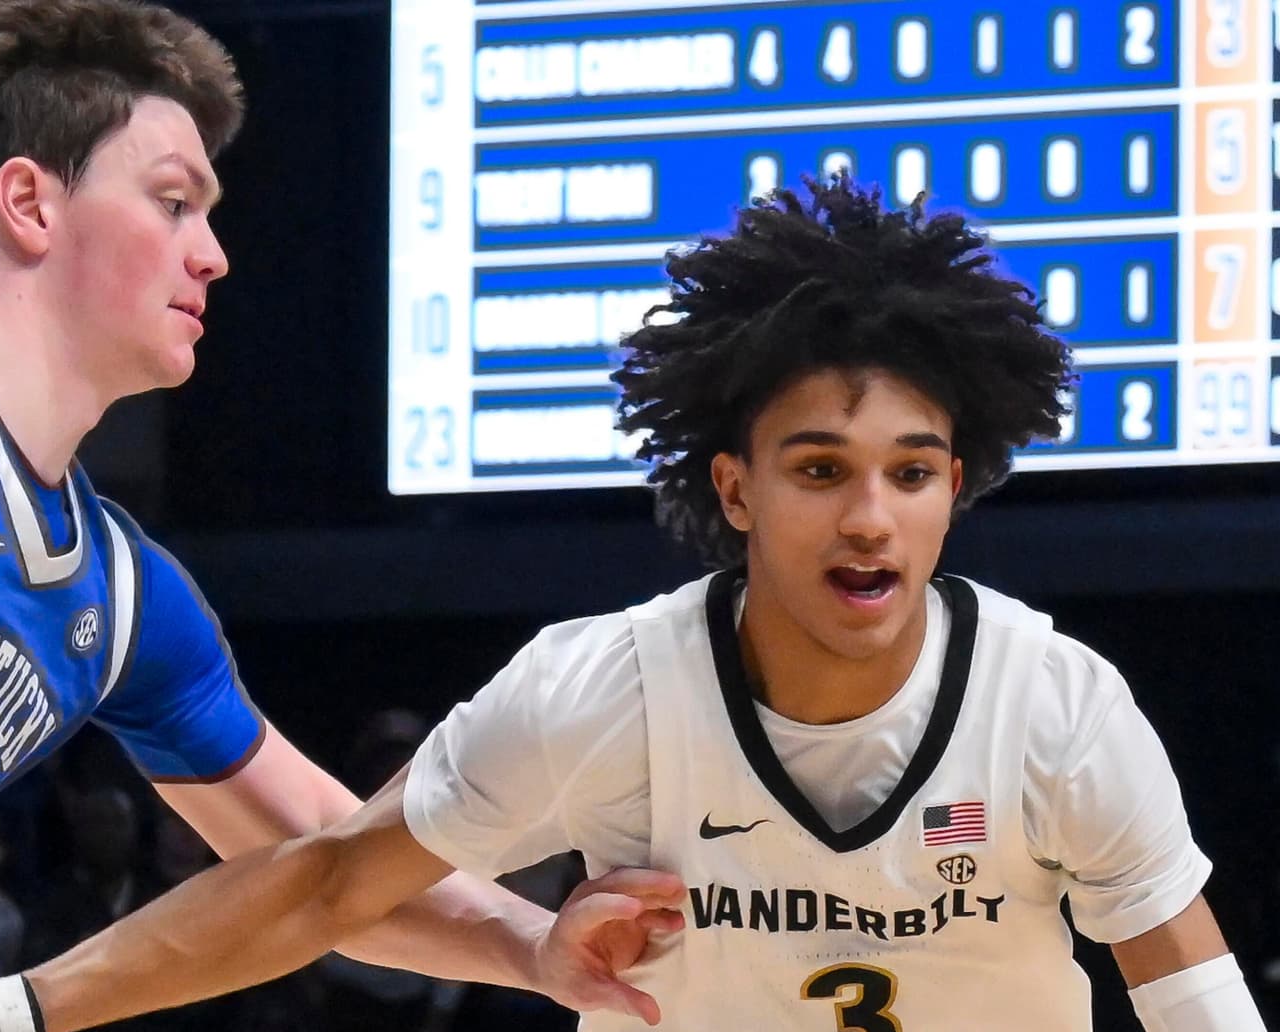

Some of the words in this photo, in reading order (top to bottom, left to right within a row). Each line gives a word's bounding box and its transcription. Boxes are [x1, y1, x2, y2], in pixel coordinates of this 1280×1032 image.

[422, 43, 444, 106] 5
[749, 30, 778, 85] 4
[823, 26, 852, 81] 4
[977, 17, 998, 73] 1
[1053, 13, 1074, 69] 1
[1125, 7, 1154, 64] 2
[420, 168, 444, 231] 9
[1129, 136, 1149, 193] 1
[1128, 266, 1148, 322] 1
[1205, 246, 1245, 329] 7
[403, 404, 455, 468] 23
[1123, 381, 1153, 441] 2
[936, 854, 976, 885] SEC
[688, 882, 1006, 941] VANDERBILT
